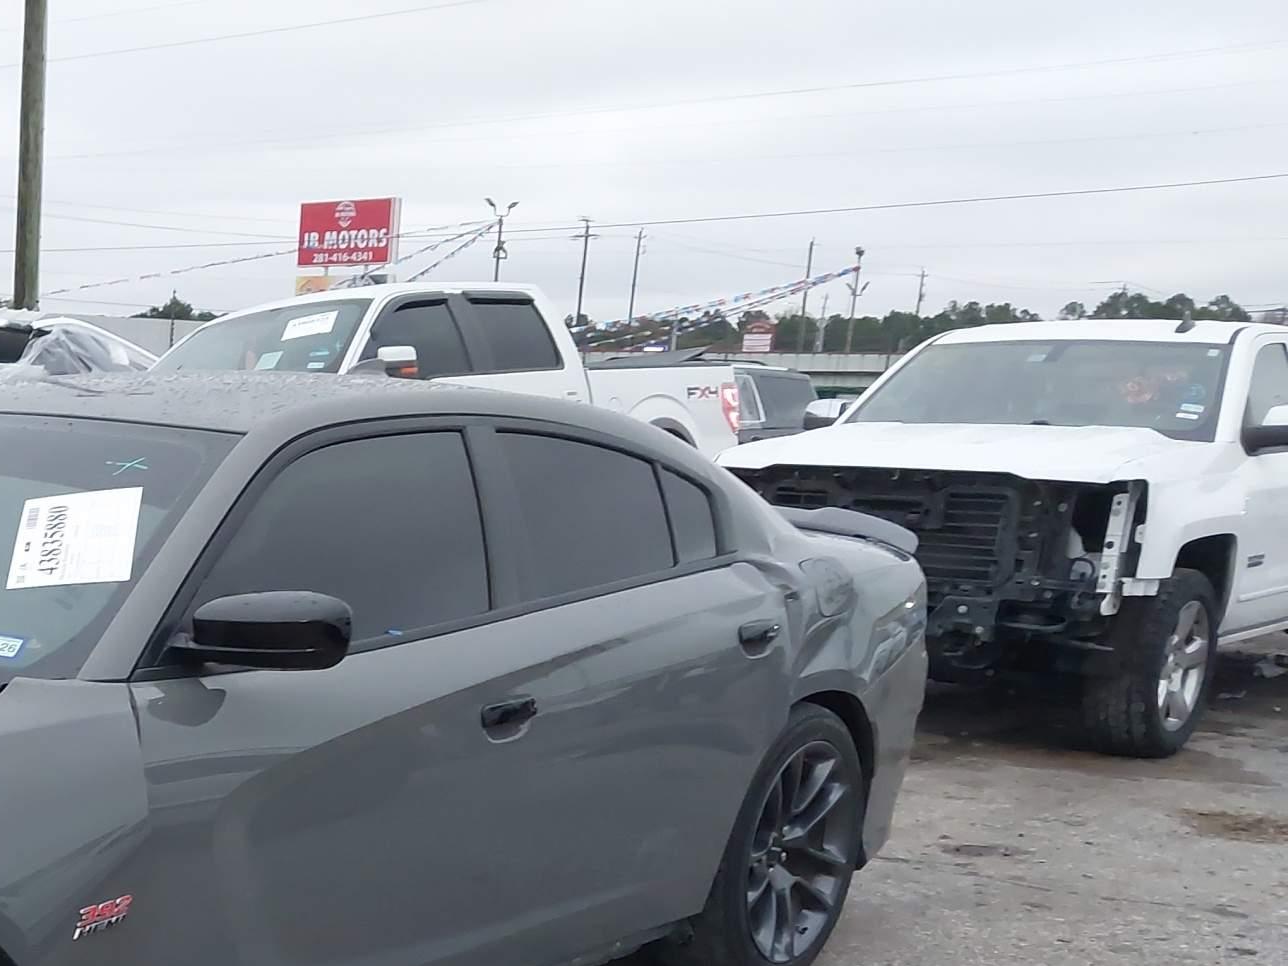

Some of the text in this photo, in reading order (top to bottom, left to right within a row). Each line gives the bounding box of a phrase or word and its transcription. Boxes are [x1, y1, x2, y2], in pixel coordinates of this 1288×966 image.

[323, 229, 388, 250] MOTORS
[312, 251, 373, 263] 281-416-4341
[687, 386, 718, 399] FX4
[37, 505, 69, 576] 43835880
[76, 894, 133, 927] 392
